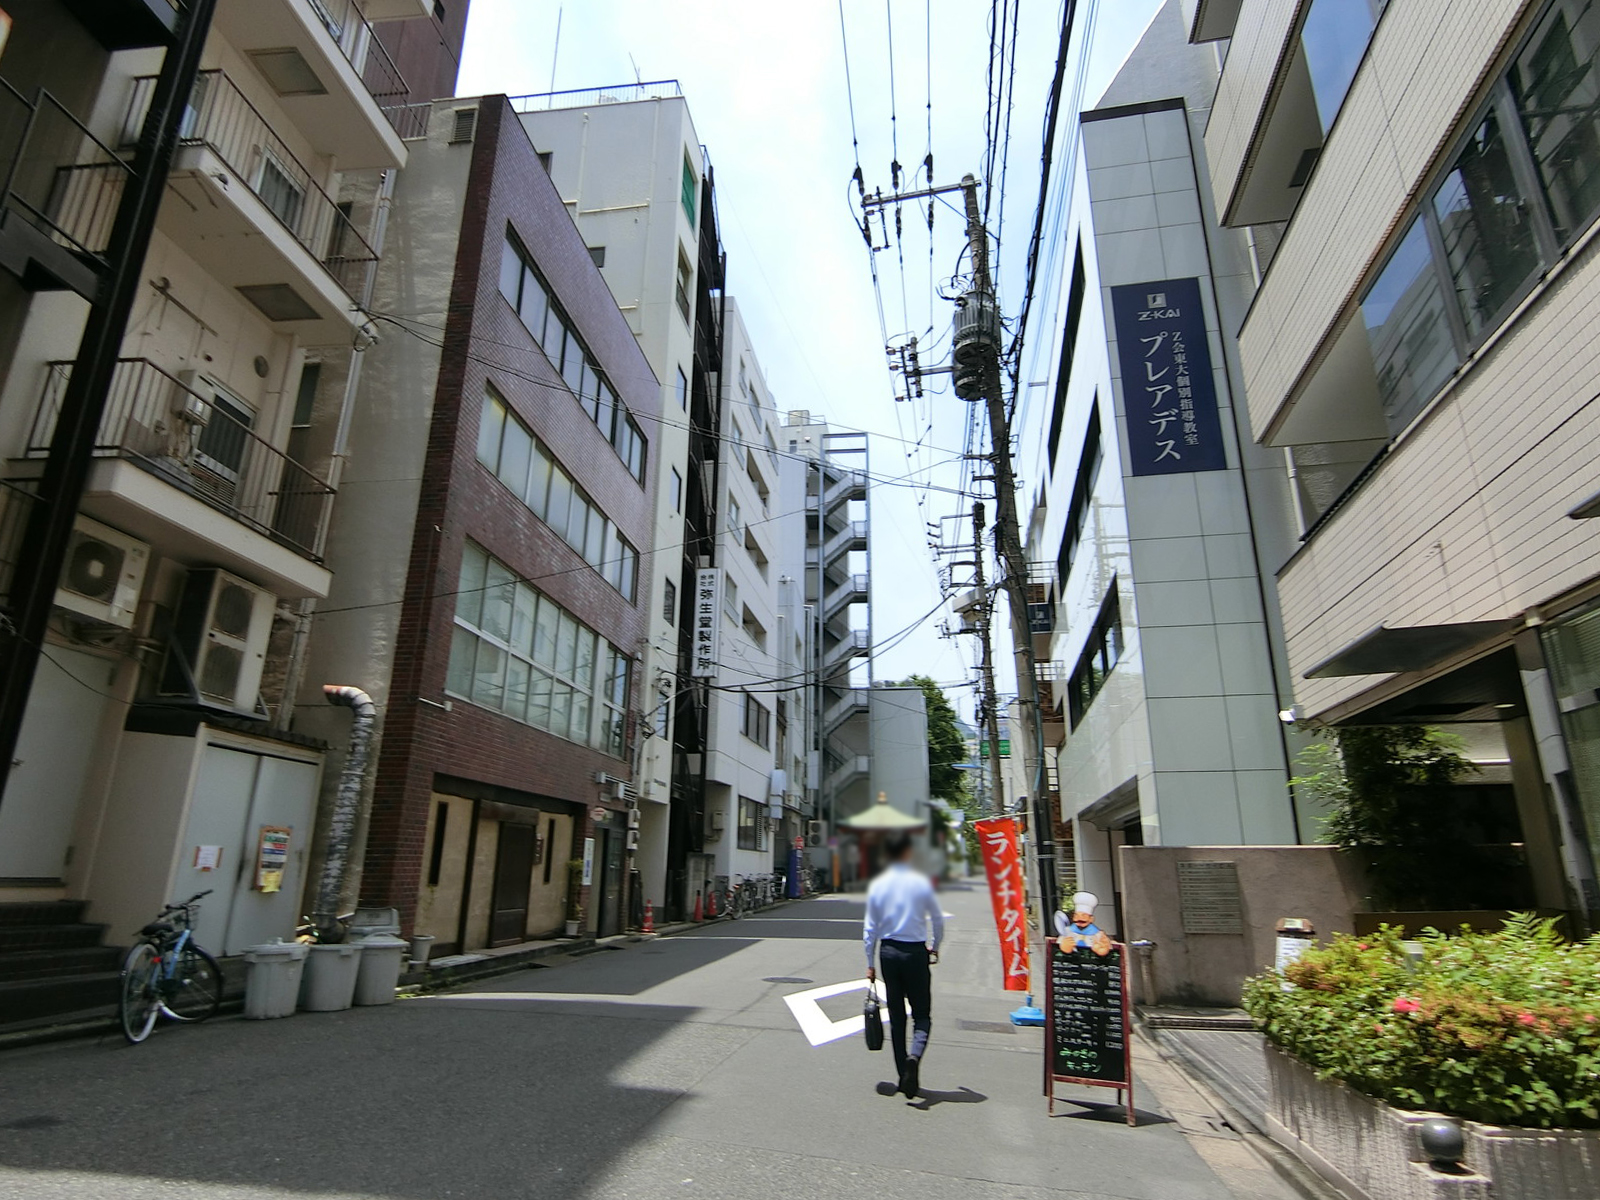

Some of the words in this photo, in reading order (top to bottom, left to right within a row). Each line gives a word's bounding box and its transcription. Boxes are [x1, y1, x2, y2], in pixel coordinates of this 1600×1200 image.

[1140, 331, 1181, 463] プレアデス
[1172, 331, 1199, 446] Z会東大個別指導教室
[986, 831, 1029, 977] ランチタイム
